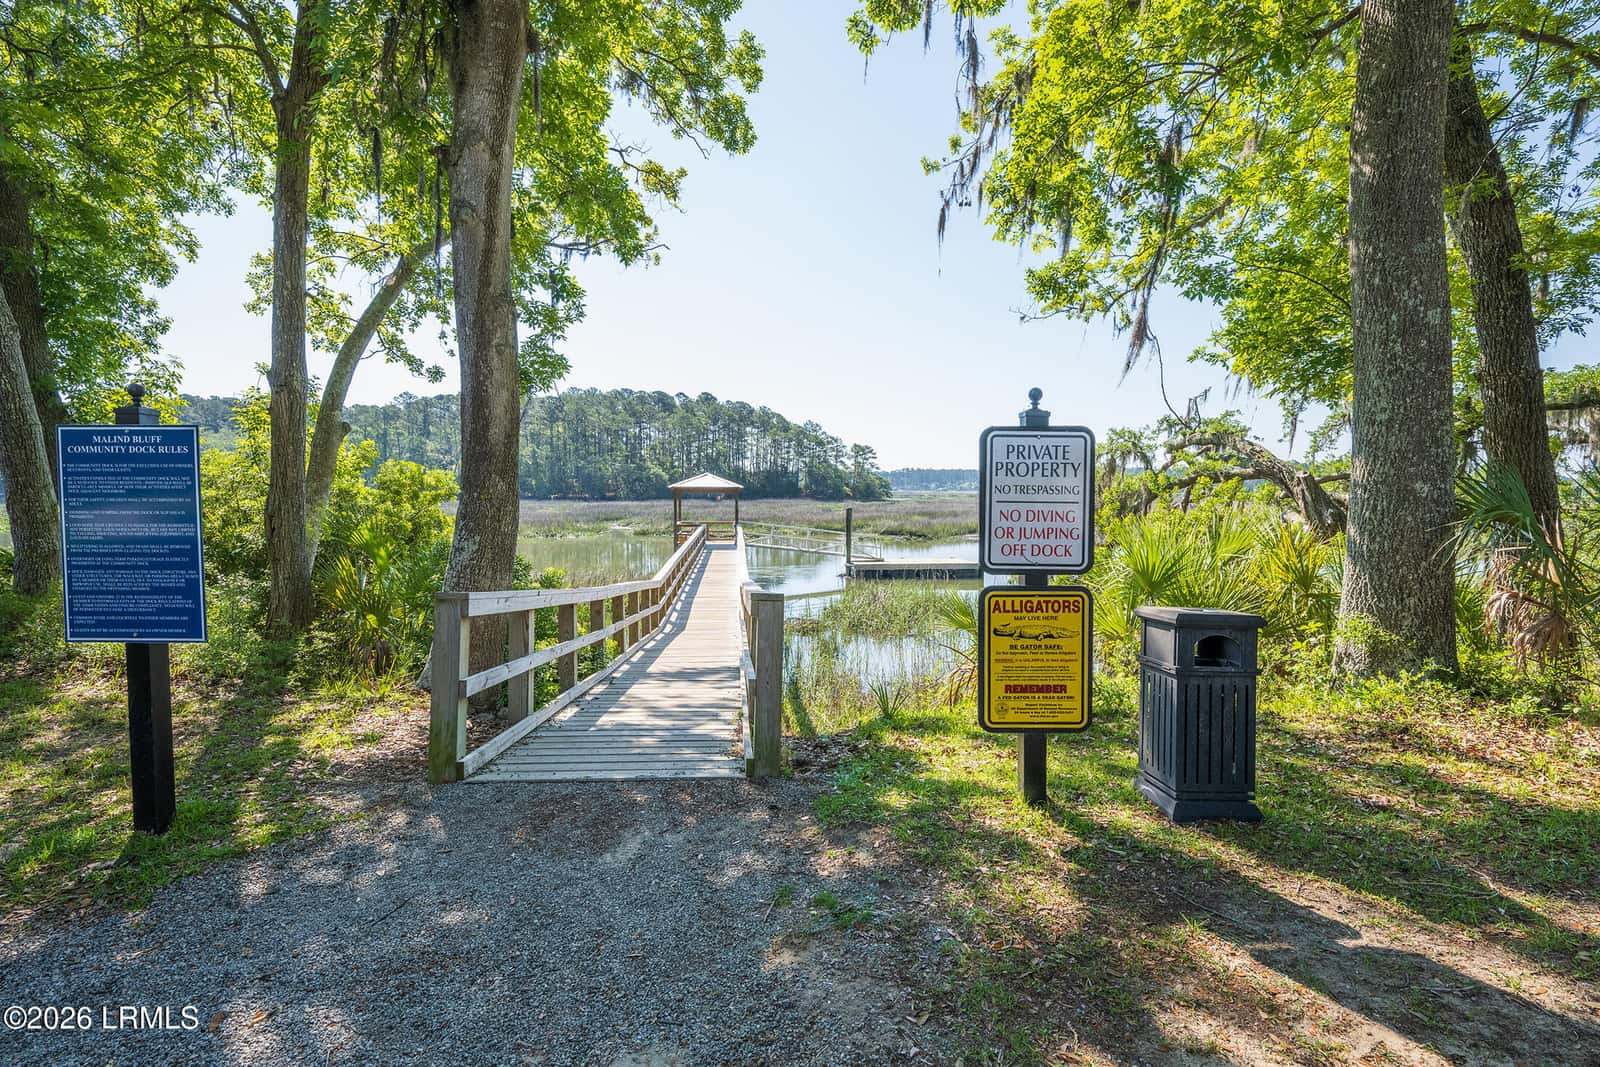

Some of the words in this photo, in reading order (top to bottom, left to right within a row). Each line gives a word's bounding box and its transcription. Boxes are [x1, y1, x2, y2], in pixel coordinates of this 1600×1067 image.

[93, 435, 130, 443] MALIND
[132, 435, 162, 443] BLUFF
[67, 445, 127, 454] COMMUNITY
[129, 445, 156, 454] DOCK
[158, 445, 189, 454] RULES
[1006, 444, 1070, 460] PRIVATE
[995, 462, 1081, 478] PROPERTY
[994, 484, 1011, 495] NO
[1013, 484, 1080, 495] TRESPASSING
[999, 510, 1021, 523] NO
[1026, 510, 1075, 523] DIVING
[994, 527, 1014, 539] OR
[1018, 527, 1080, 541] JUMPING
[1001, 544, 1026, 557] OFF
[1031, 544, 1073, 557] DOCK
[992, 600, 1080, 613] ALLIGATORS
[1004, 684, 1067, 694] REMEMBER
